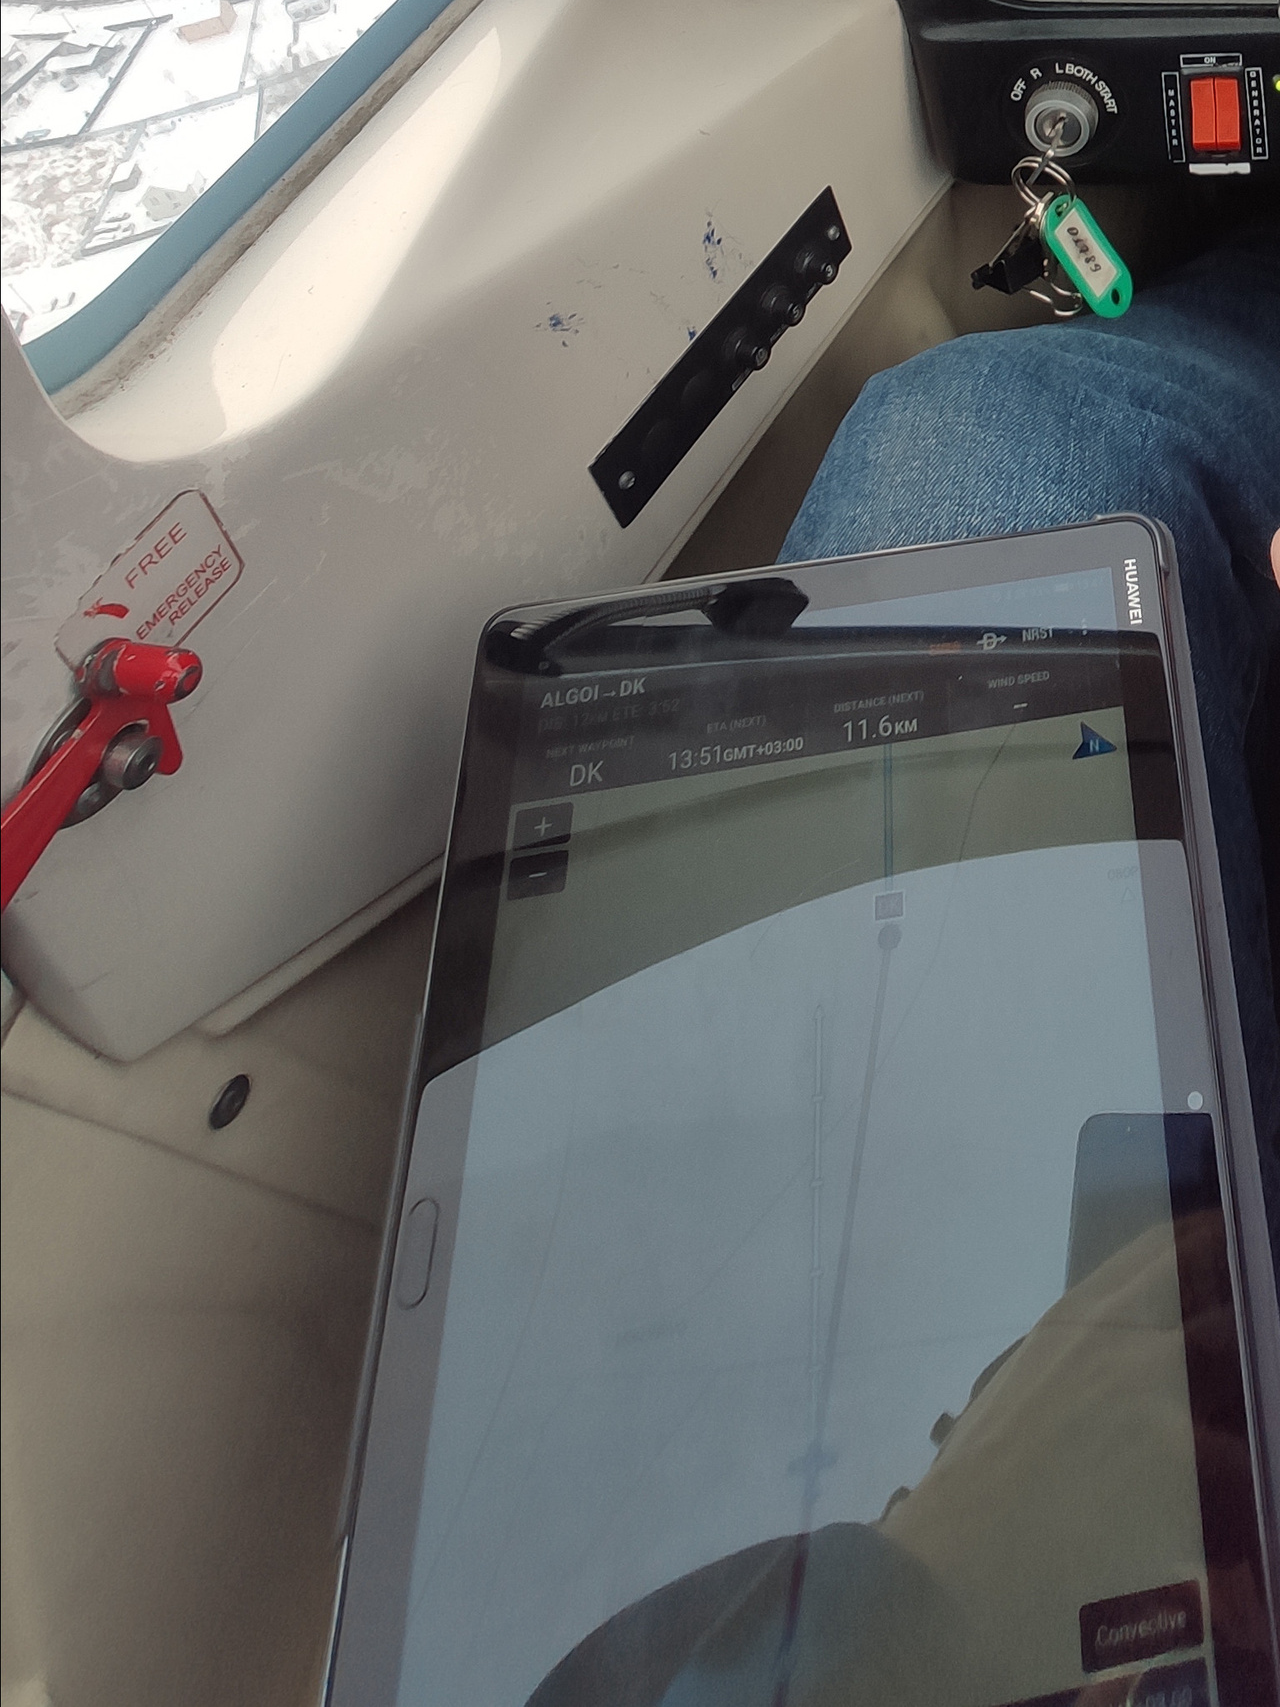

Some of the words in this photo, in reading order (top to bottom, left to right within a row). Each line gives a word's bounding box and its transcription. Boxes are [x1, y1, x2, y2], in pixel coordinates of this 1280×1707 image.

[1055, 62, 1064, 74] L
[1204, 56, 1216, 64] ON
[1030, 67, 1042, 80] R
[1065, 63, 1099, 86] BOTH
[1010, 78, 1027, 101] OFF
[1095, 80, 1118, 114] START
[1168, 89, 1179, 147] MASTER
[1250, 71, 1263, 155] GENERATOR
[124, 522, 187, 589] FREE
[136, 544, 223, 641] EMERGENCY
[168, 557, 232, 626] RELEASE
[1124, 558, 1143, 625] HUAWEI
[987, 676, 1015, 689] WIND
[1018, 671, 1050, 685] SPEED
[834, 696, 886, 713] DISTANCE
[889, 690, 925, 707] (NEXT)
[707, 720, 727, 734] ETA
[730, 715, 767, 732] (NEXT)
[1089, 740, 1099, 753] N
[569, 760, 604, 787] DK
